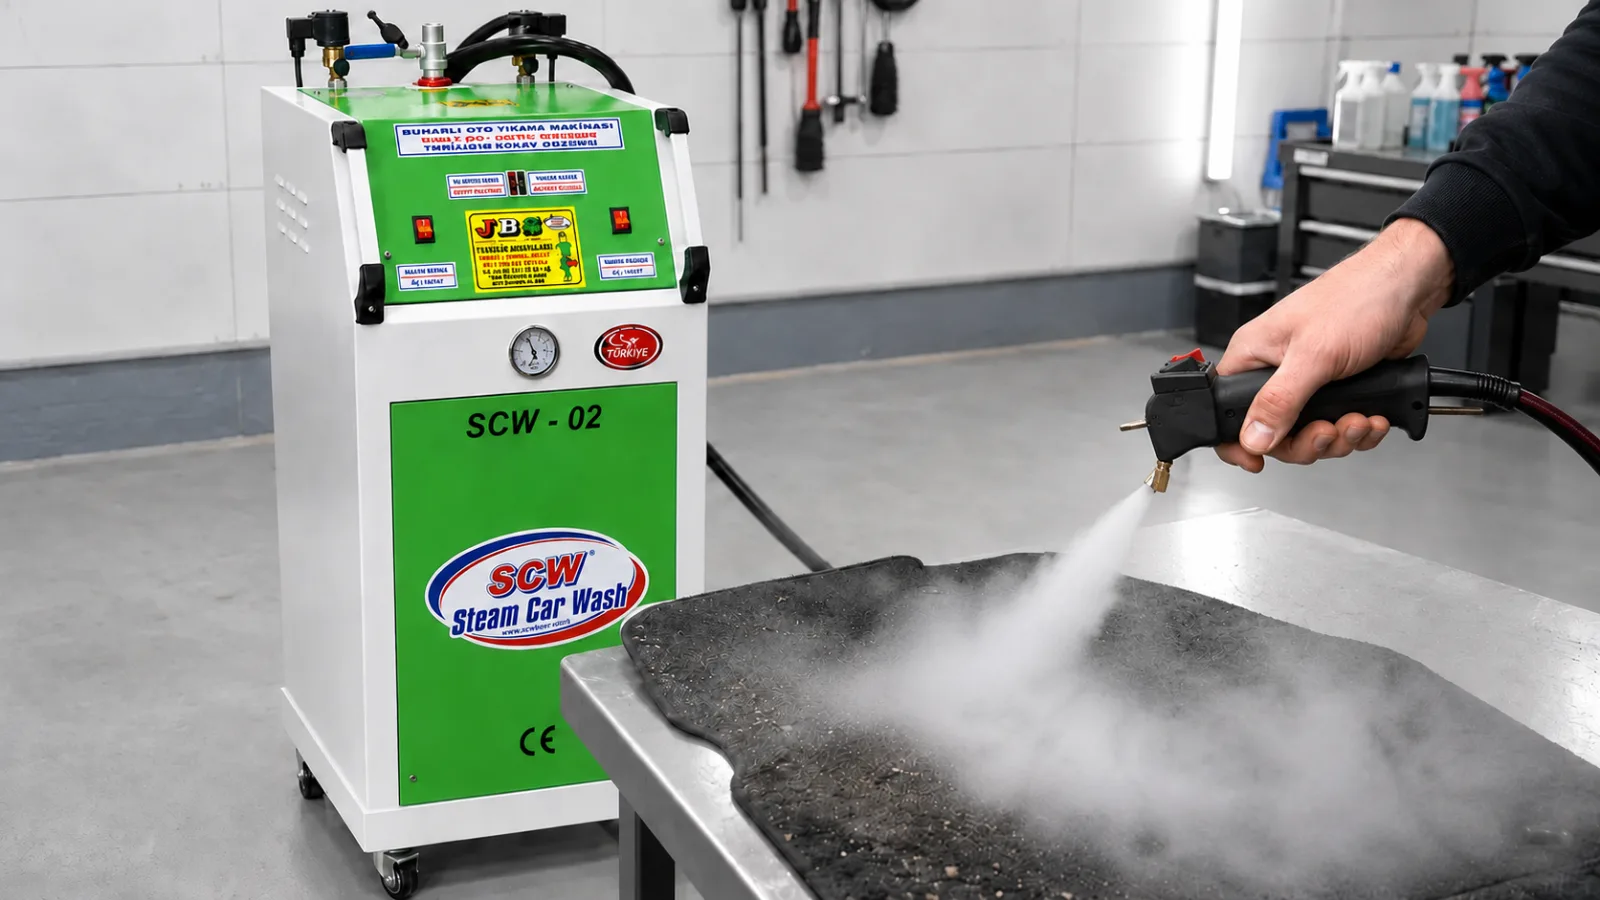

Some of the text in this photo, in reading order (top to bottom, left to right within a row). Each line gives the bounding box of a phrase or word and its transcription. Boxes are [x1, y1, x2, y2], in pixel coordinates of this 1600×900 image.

[402, 127, 462, 136] BUHARLI
[466, 126, 493, 134] OTO
[497, 124, 545, 132] YIKAMA
[466, 408, 540, 438] SCW
[568, 404, 602, 430] 02
[487, 551, 587, 598] SCW
[452, 582, 629, 636] Steam Car Wash
